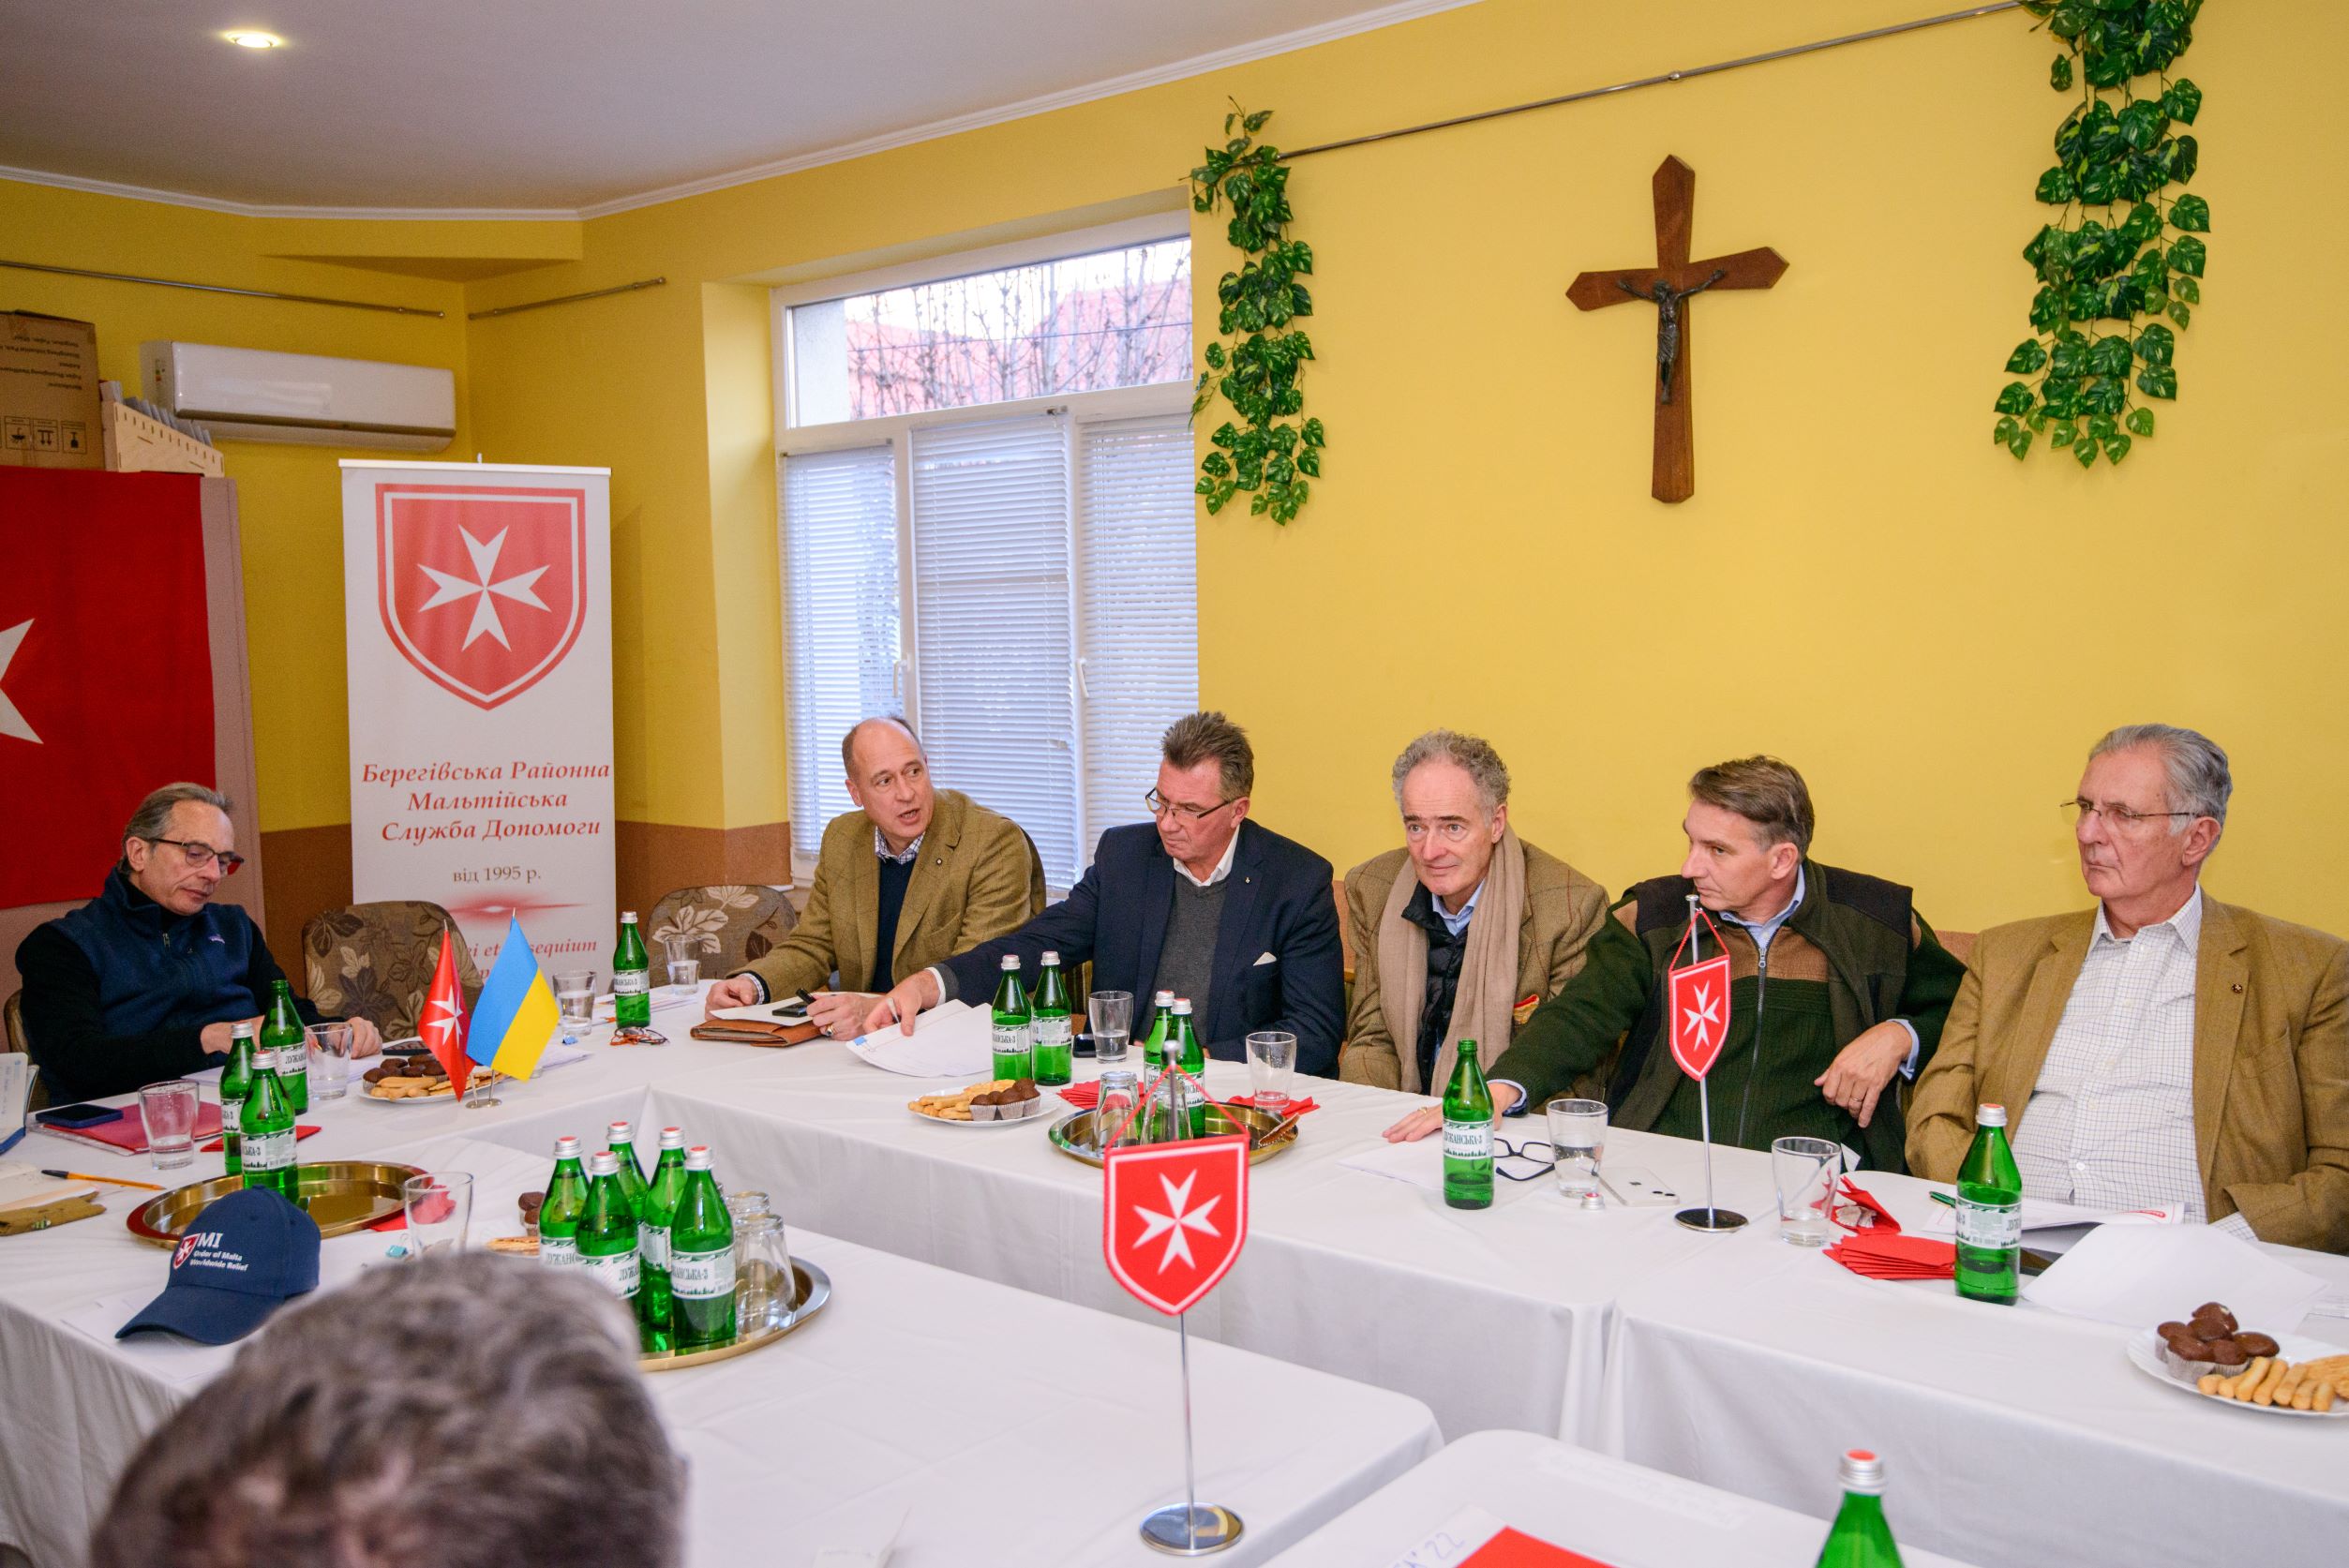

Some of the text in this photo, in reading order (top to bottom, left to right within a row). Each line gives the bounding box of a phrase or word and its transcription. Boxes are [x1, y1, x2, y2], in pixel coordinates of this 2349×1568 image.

[362, 760, 610, 787] Берегівська Районна
[407, 790, 568, 811] Мальтійська
[382, 818, 601, 845] Служба Допомоги
[454, 866, 542, 884] від 1995 р.
[530, 939, 597, 957] sequium
[197, 1232, 223, 1247] MI
[190, 1259, 248, 1271] Worldwide Relief
[222, 1252, 242, 1261] Malta
